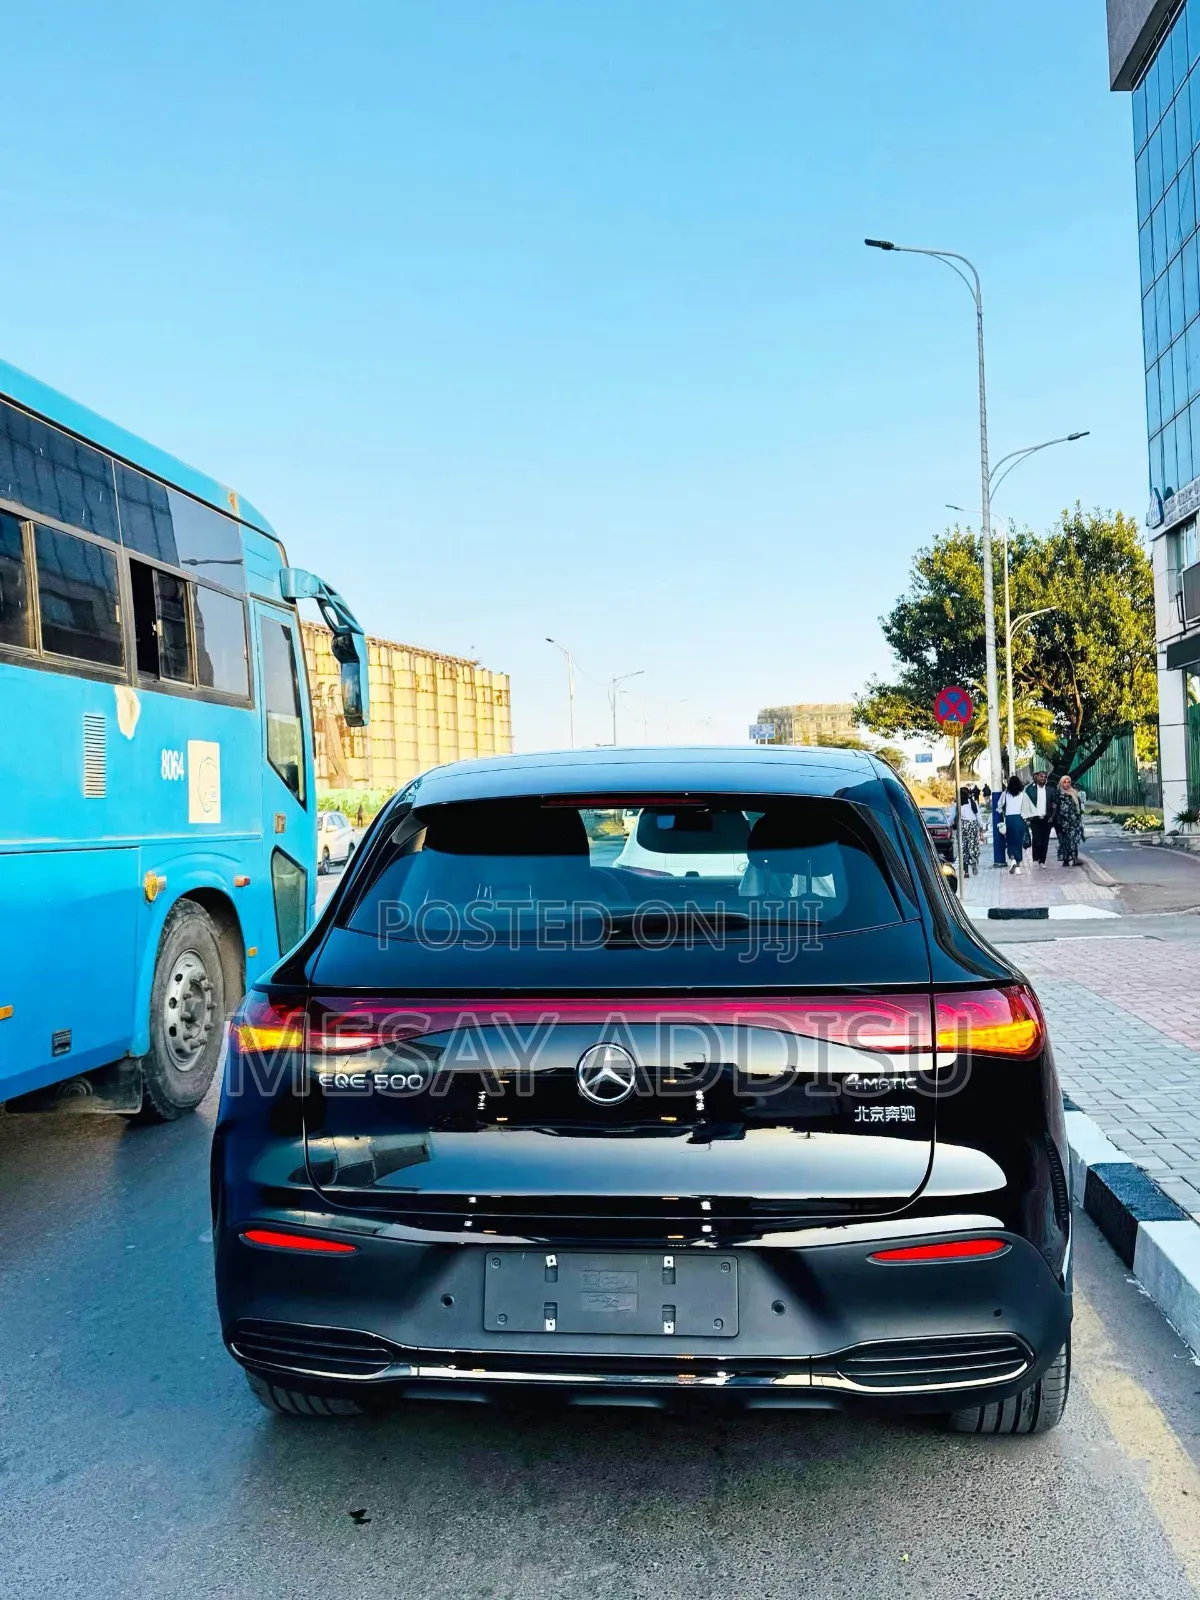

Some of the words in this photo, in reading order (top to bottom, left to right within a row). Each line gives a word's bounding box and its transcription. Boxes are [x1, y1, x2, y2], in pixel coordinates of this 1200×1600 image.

[161, 748, 184, 781] 8064
[319, 1073, 366, 1089] EQE
[374, 1074, 424, 1090] 500
[845, 1073, 917, 1090] 4MATIC
[854, 1105, 916, 1122] 北京奔驰
